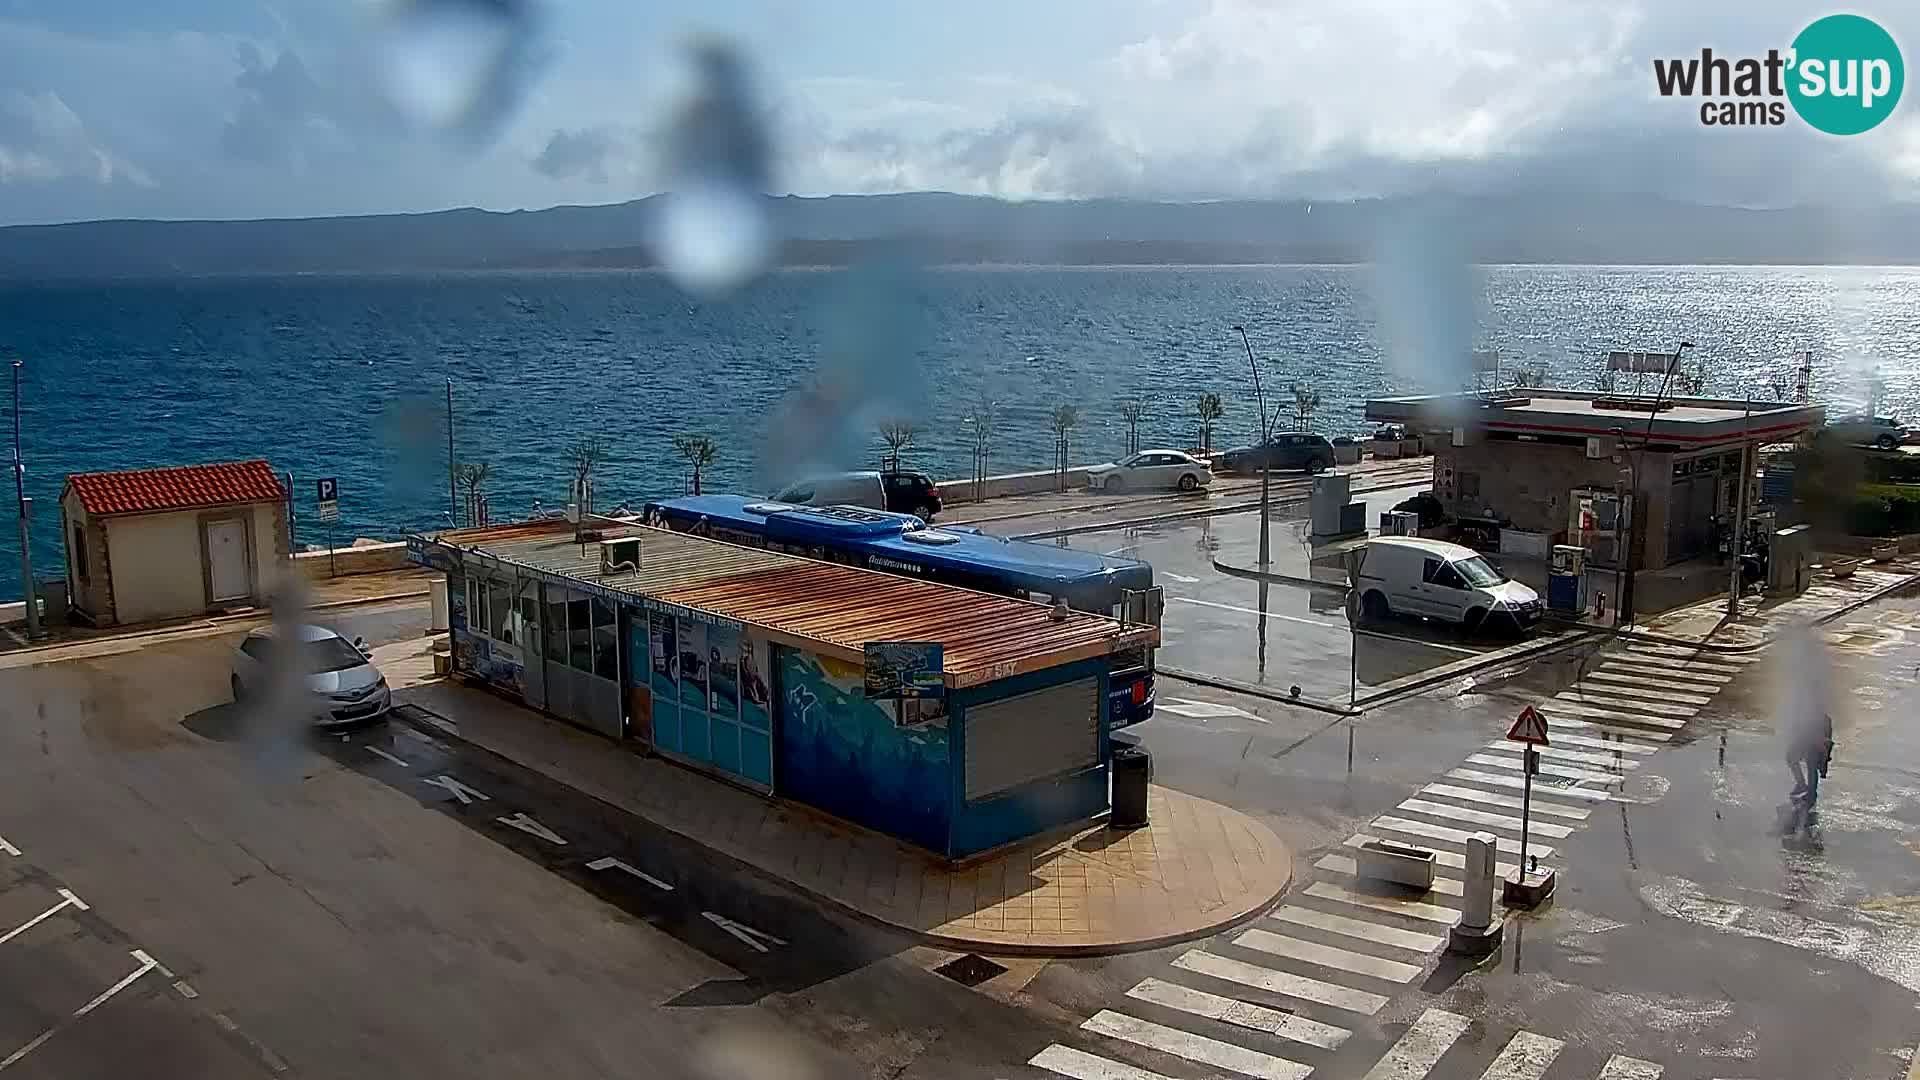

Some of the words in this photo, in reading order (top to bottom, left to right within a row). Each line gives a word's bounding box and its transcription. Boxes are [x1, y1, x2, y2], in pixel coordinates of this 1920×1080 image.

[321, 481, 333, 499] P
[659, 604, 689, 617] STATION
[692, 611, 716, 625] TICKET
[718, 618, 742, 632] OFFICE
